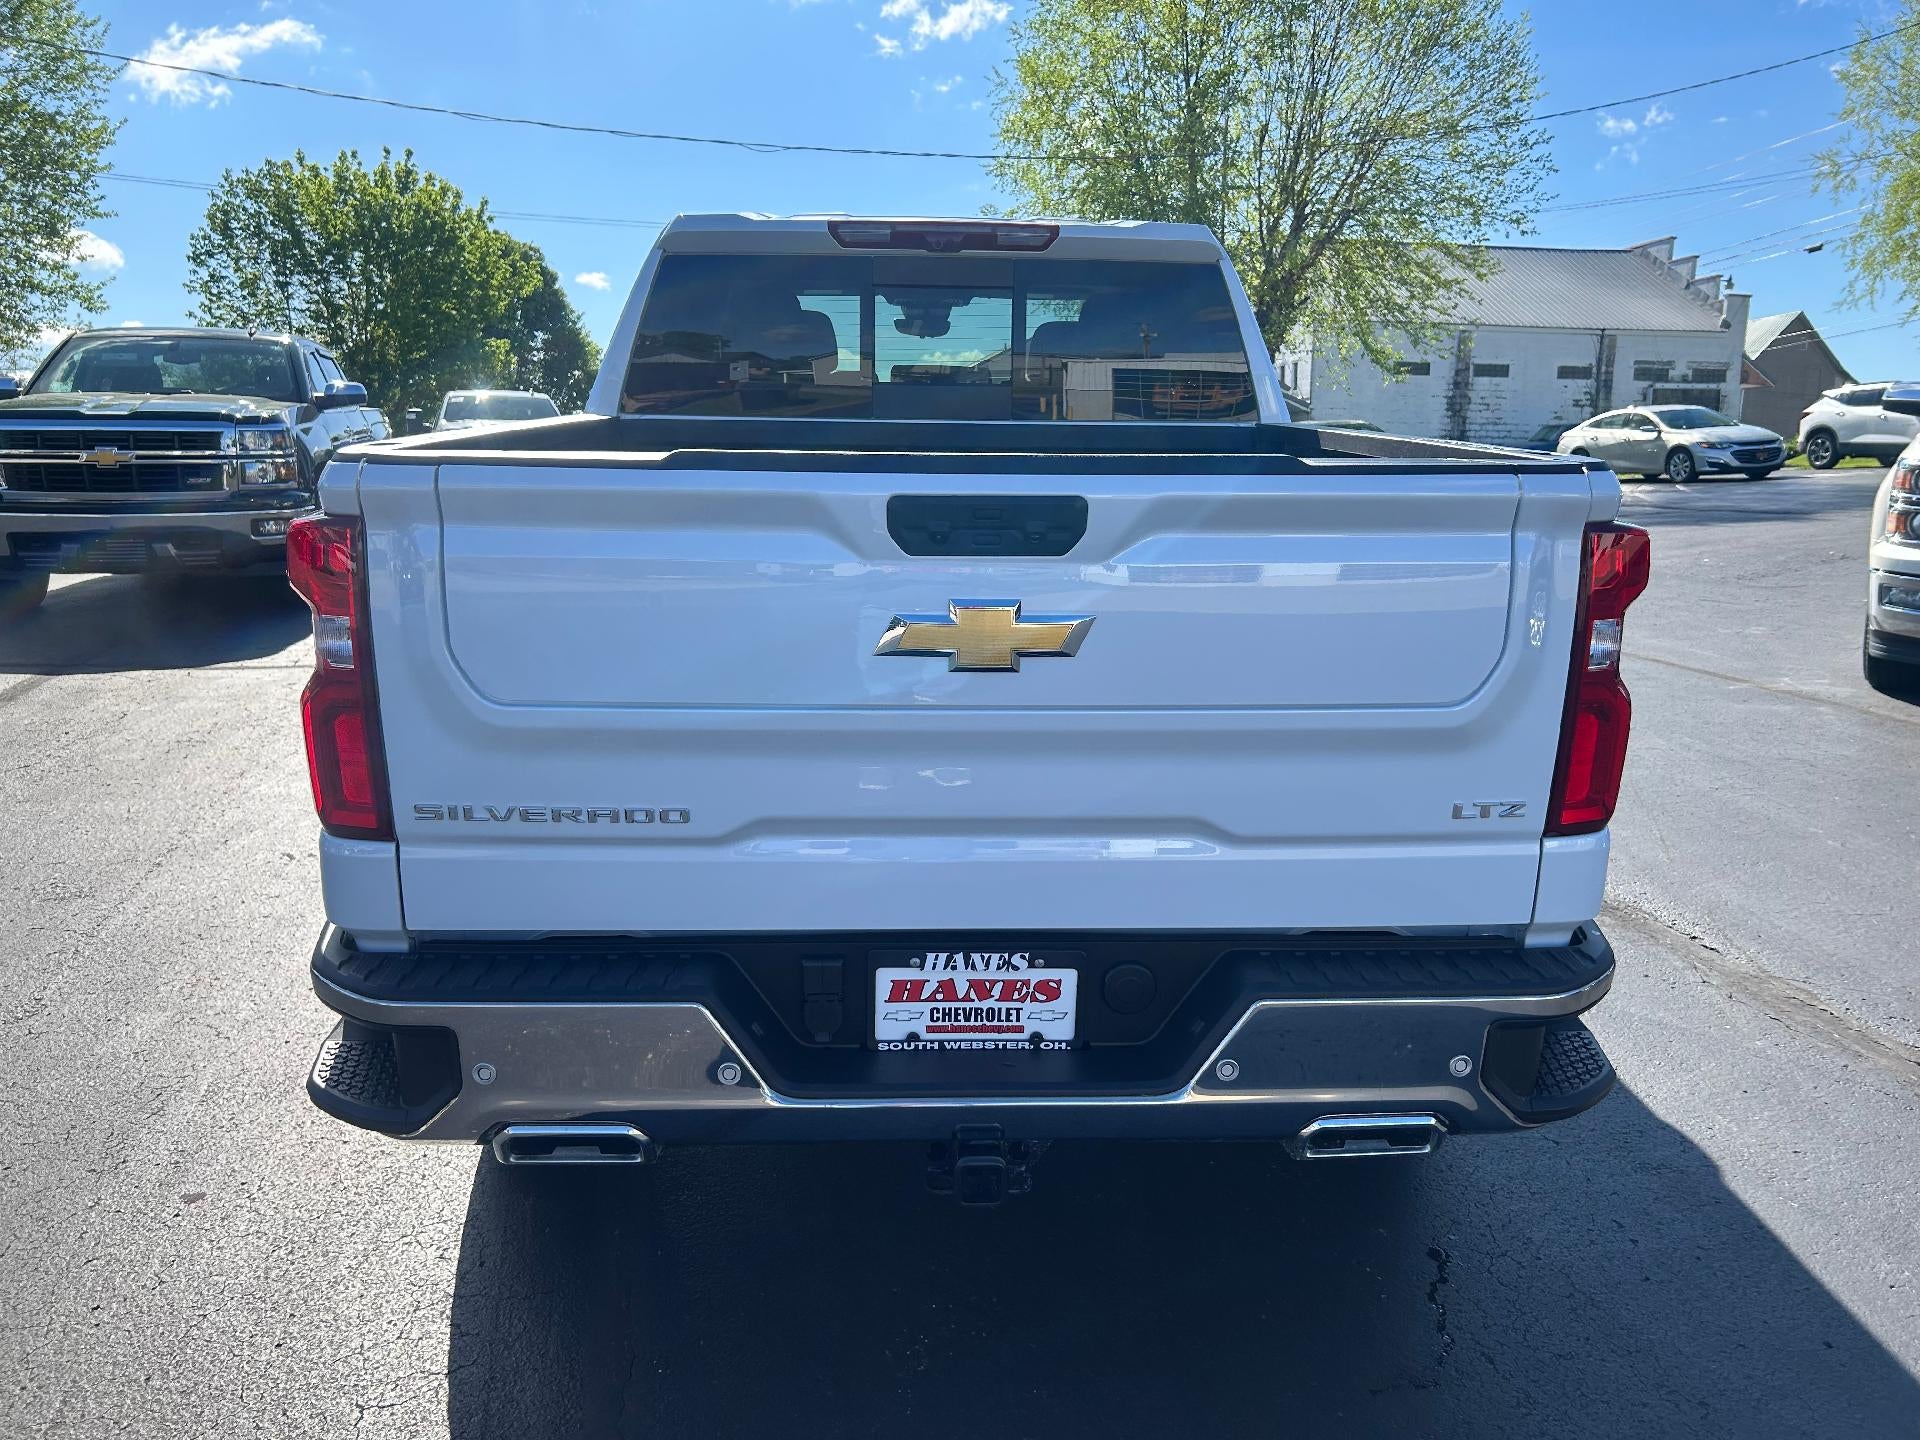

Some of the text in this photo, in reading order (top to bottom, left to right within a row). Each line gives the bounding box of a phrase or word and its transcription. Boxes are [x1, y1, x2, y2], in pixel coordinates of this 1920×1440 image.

[413, 803, 691, 824] SILVERADO
[1451, 800, 1527, 820] LTZ
[920, 951, 1030, 972] HANES
[884, 977, 1063, 1004] HANES
[929, 1007, 1024, 1023] CHEVROLET
[877, 1041, 1071, 1051] SOUTH WEBSTER, OH.
